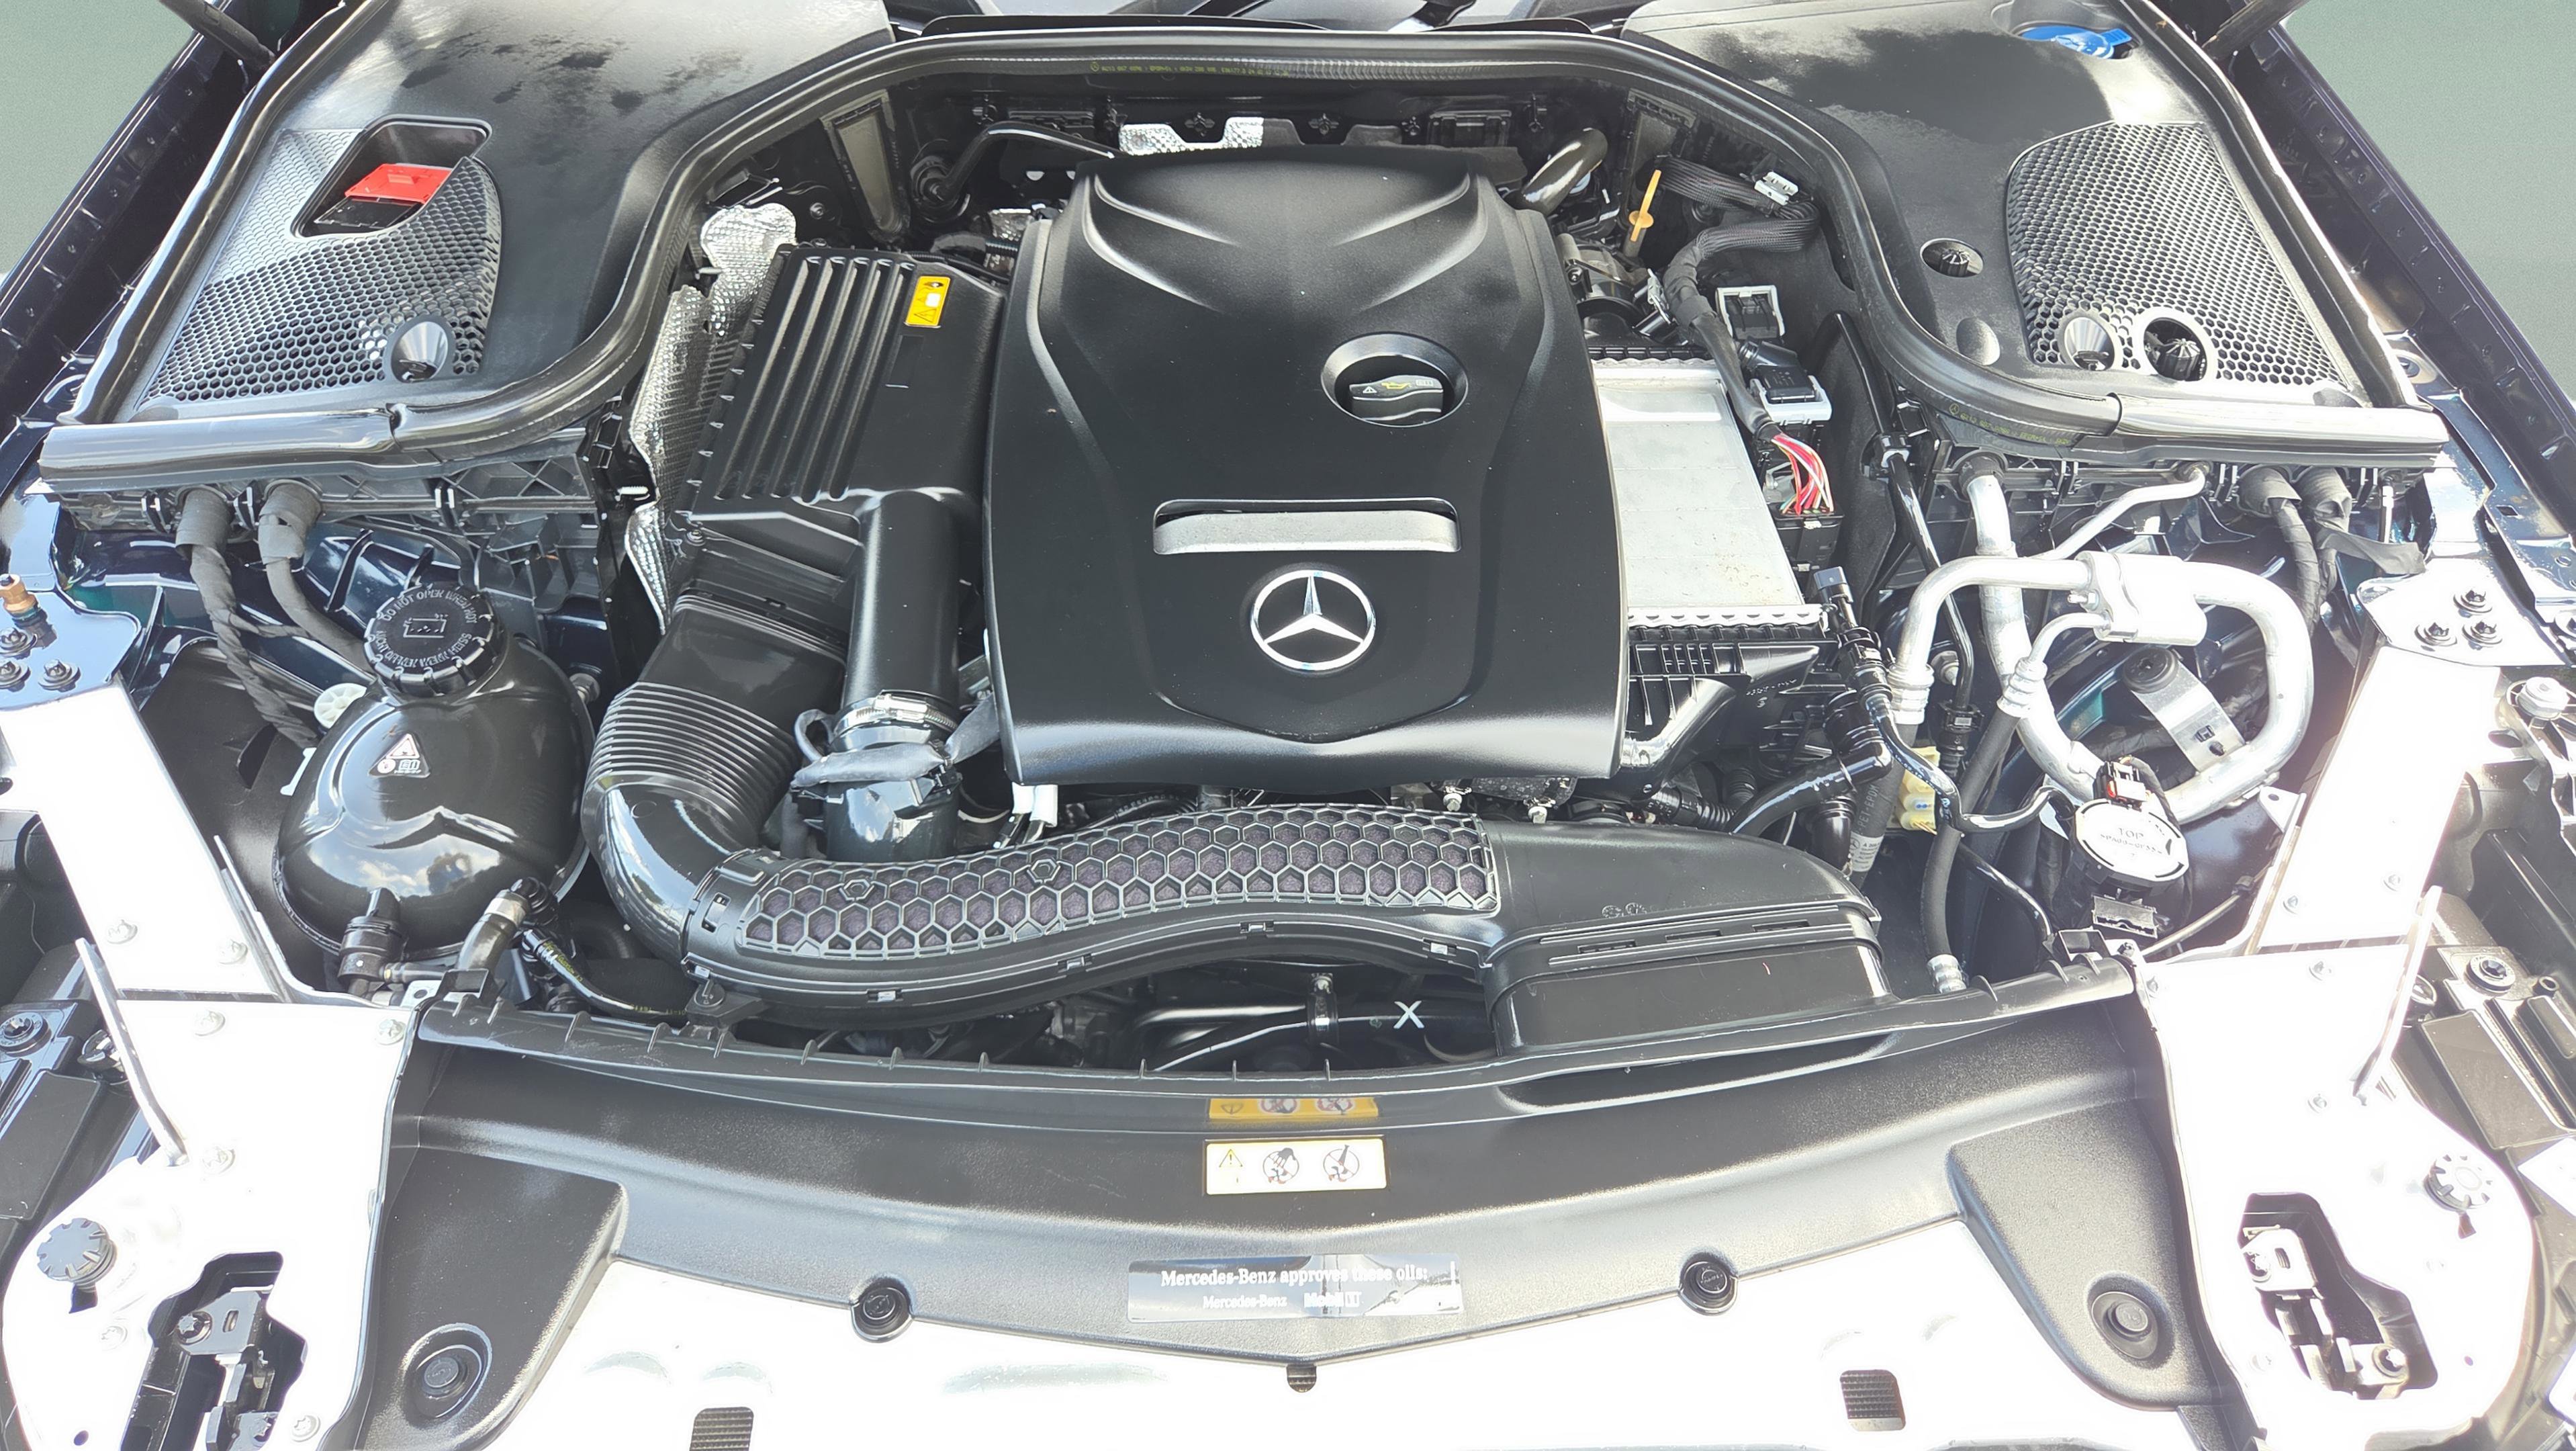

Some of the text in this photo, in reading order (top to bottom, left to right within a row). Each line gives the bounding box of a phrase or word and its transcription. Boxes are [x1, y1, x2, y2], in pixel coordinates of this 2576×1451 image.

[383, 609, 397, 621] DO
[394, 595, 414, 610] NOT
[416, 589, 444, 600] OPEN
[448, 632, 472, 656] HEISS
[2118, 827, 2144, 839] TOP
[1393, 1000, 1424, 1029] X
[1161, 1264, 1428, 1287] Mercedes-Benz approves these oils:
[1202, 1294, 1288, 1309] Mercedes-Benz
